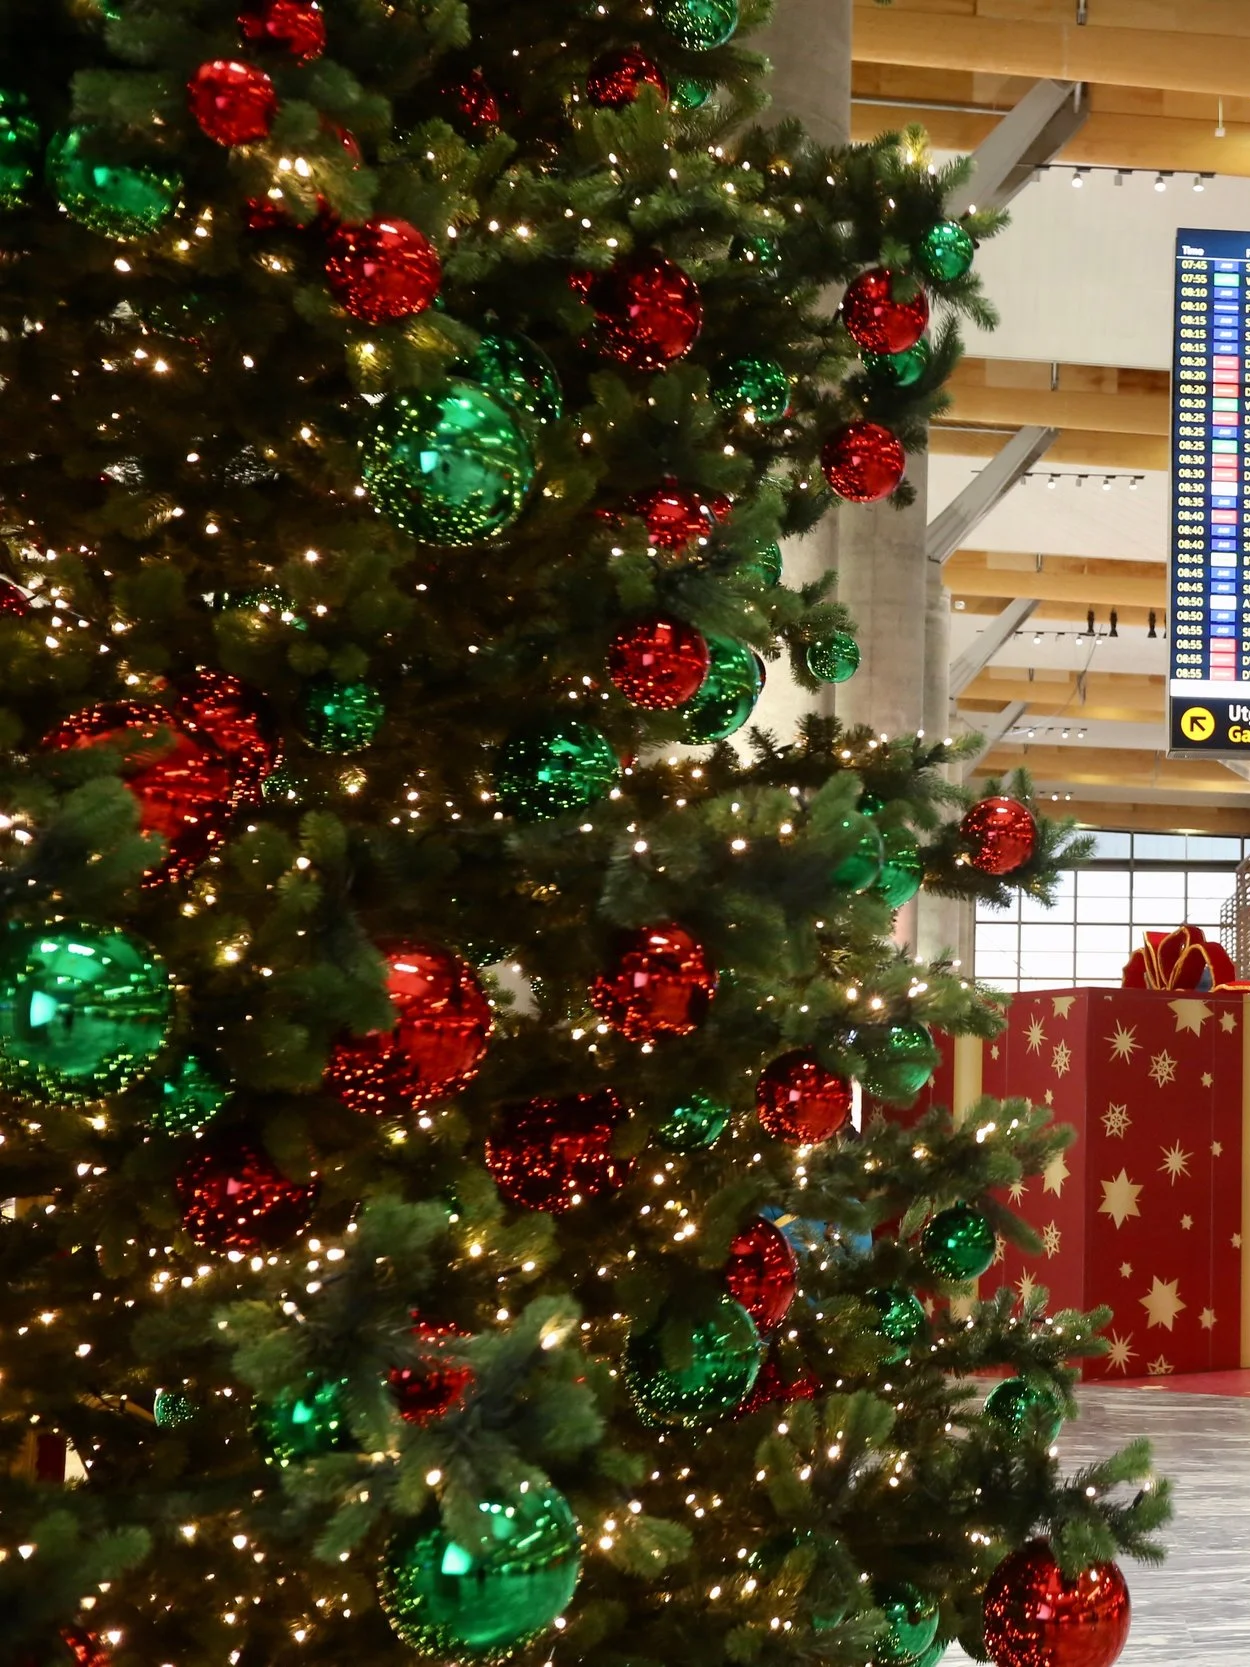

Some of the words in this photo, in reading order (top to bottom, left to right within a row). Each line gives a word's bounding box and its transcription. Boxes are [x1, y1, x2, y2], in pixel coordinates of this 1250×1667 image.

[1181, 273, 1208, 284] 07:55
[1180, 300, 1208, 312] 08:10
[1179, 356, 1207, 367] 08:20
[1179, 384, 1207, 395] 08:20
[1179, 412, 1206, 423] 08:25
[1178, 468, 1206, 479] 08:30
[1178, 482, 1205, 494] 08:30
[1177, 553, 1204, 565] 08:45
[1176, 596, 1204, 608] 08:50
[1175, 653, 1203, 665] 08:55
[1175, 667, 1203, 679] 08:55
